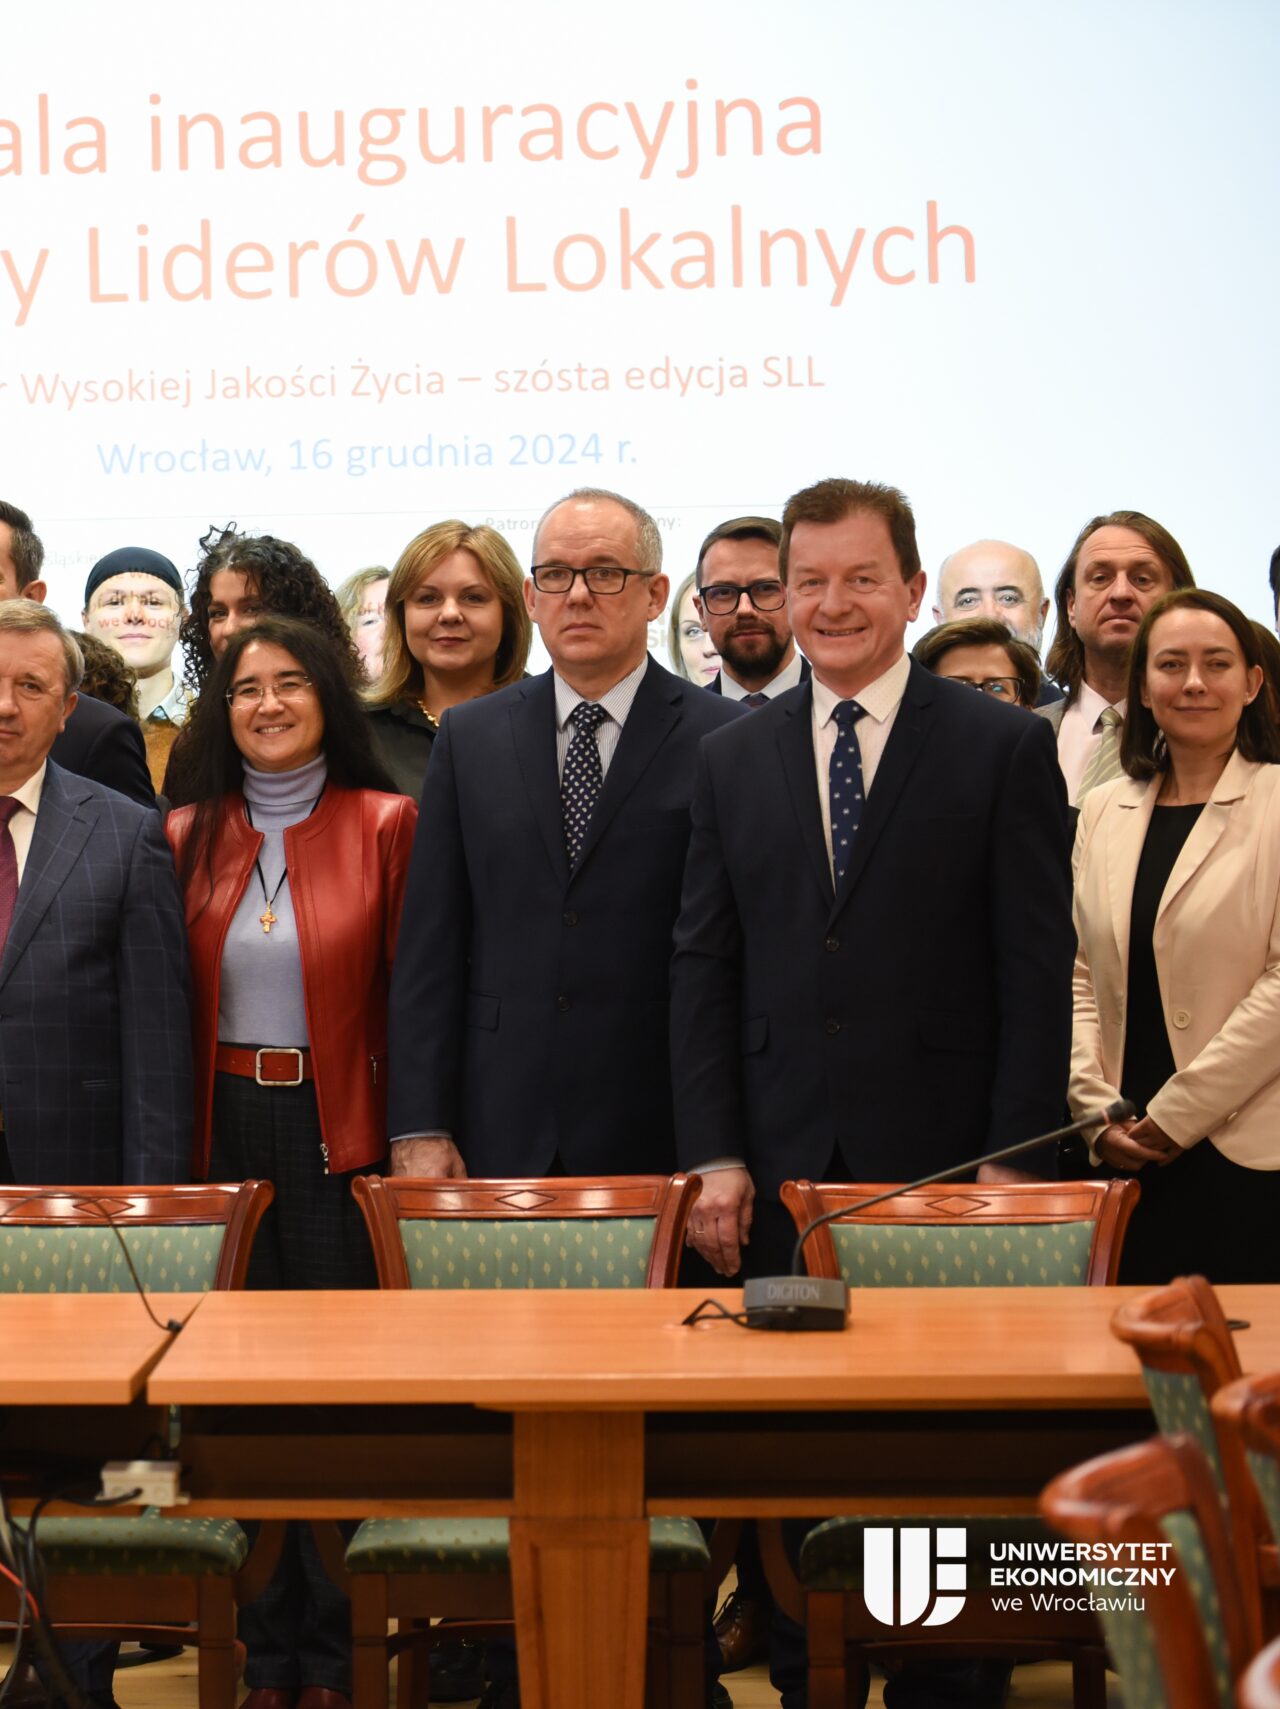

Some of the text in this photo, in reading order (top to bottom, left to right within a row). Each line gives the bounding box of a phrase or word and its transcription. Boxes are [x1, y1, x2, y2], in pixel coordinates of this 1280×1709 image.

[148, 77, 822, 187] inauguracyjna
[88, 212, 466, 304] Liderów
[505, 200, 976, 308] Lokalnych
[20, 368, 192, 411] Wysokiej
[205, 365, 336, 401] Jakości
[351, 357, 445, 404] Życia
[495, 359, 610, 393] szósta
[624, 355, 749, 397] edycja
[763, 355, 826, 388] SLL
[96, 432, 637, 478] Wrocław, 16 grudnia 2024 r.
